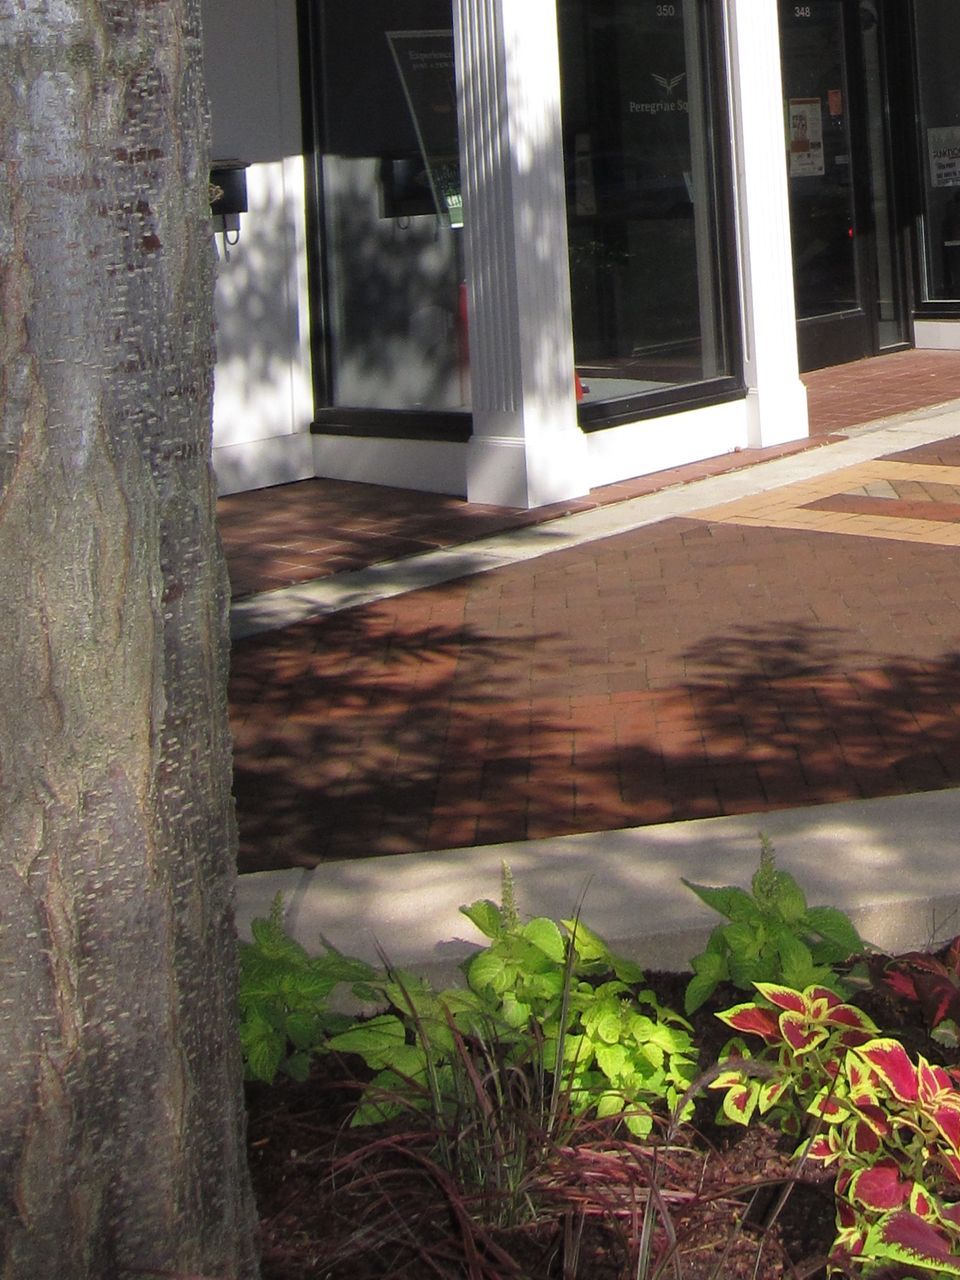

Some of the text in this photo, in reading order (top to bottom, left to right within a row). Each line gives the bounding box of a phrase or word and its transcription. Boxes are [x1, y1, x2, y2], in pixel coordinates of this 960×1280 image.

[656, 4, 675, 17] 350
[794, 6, 811, 18] 348
[629, 100, 676, 115] Peregrine
